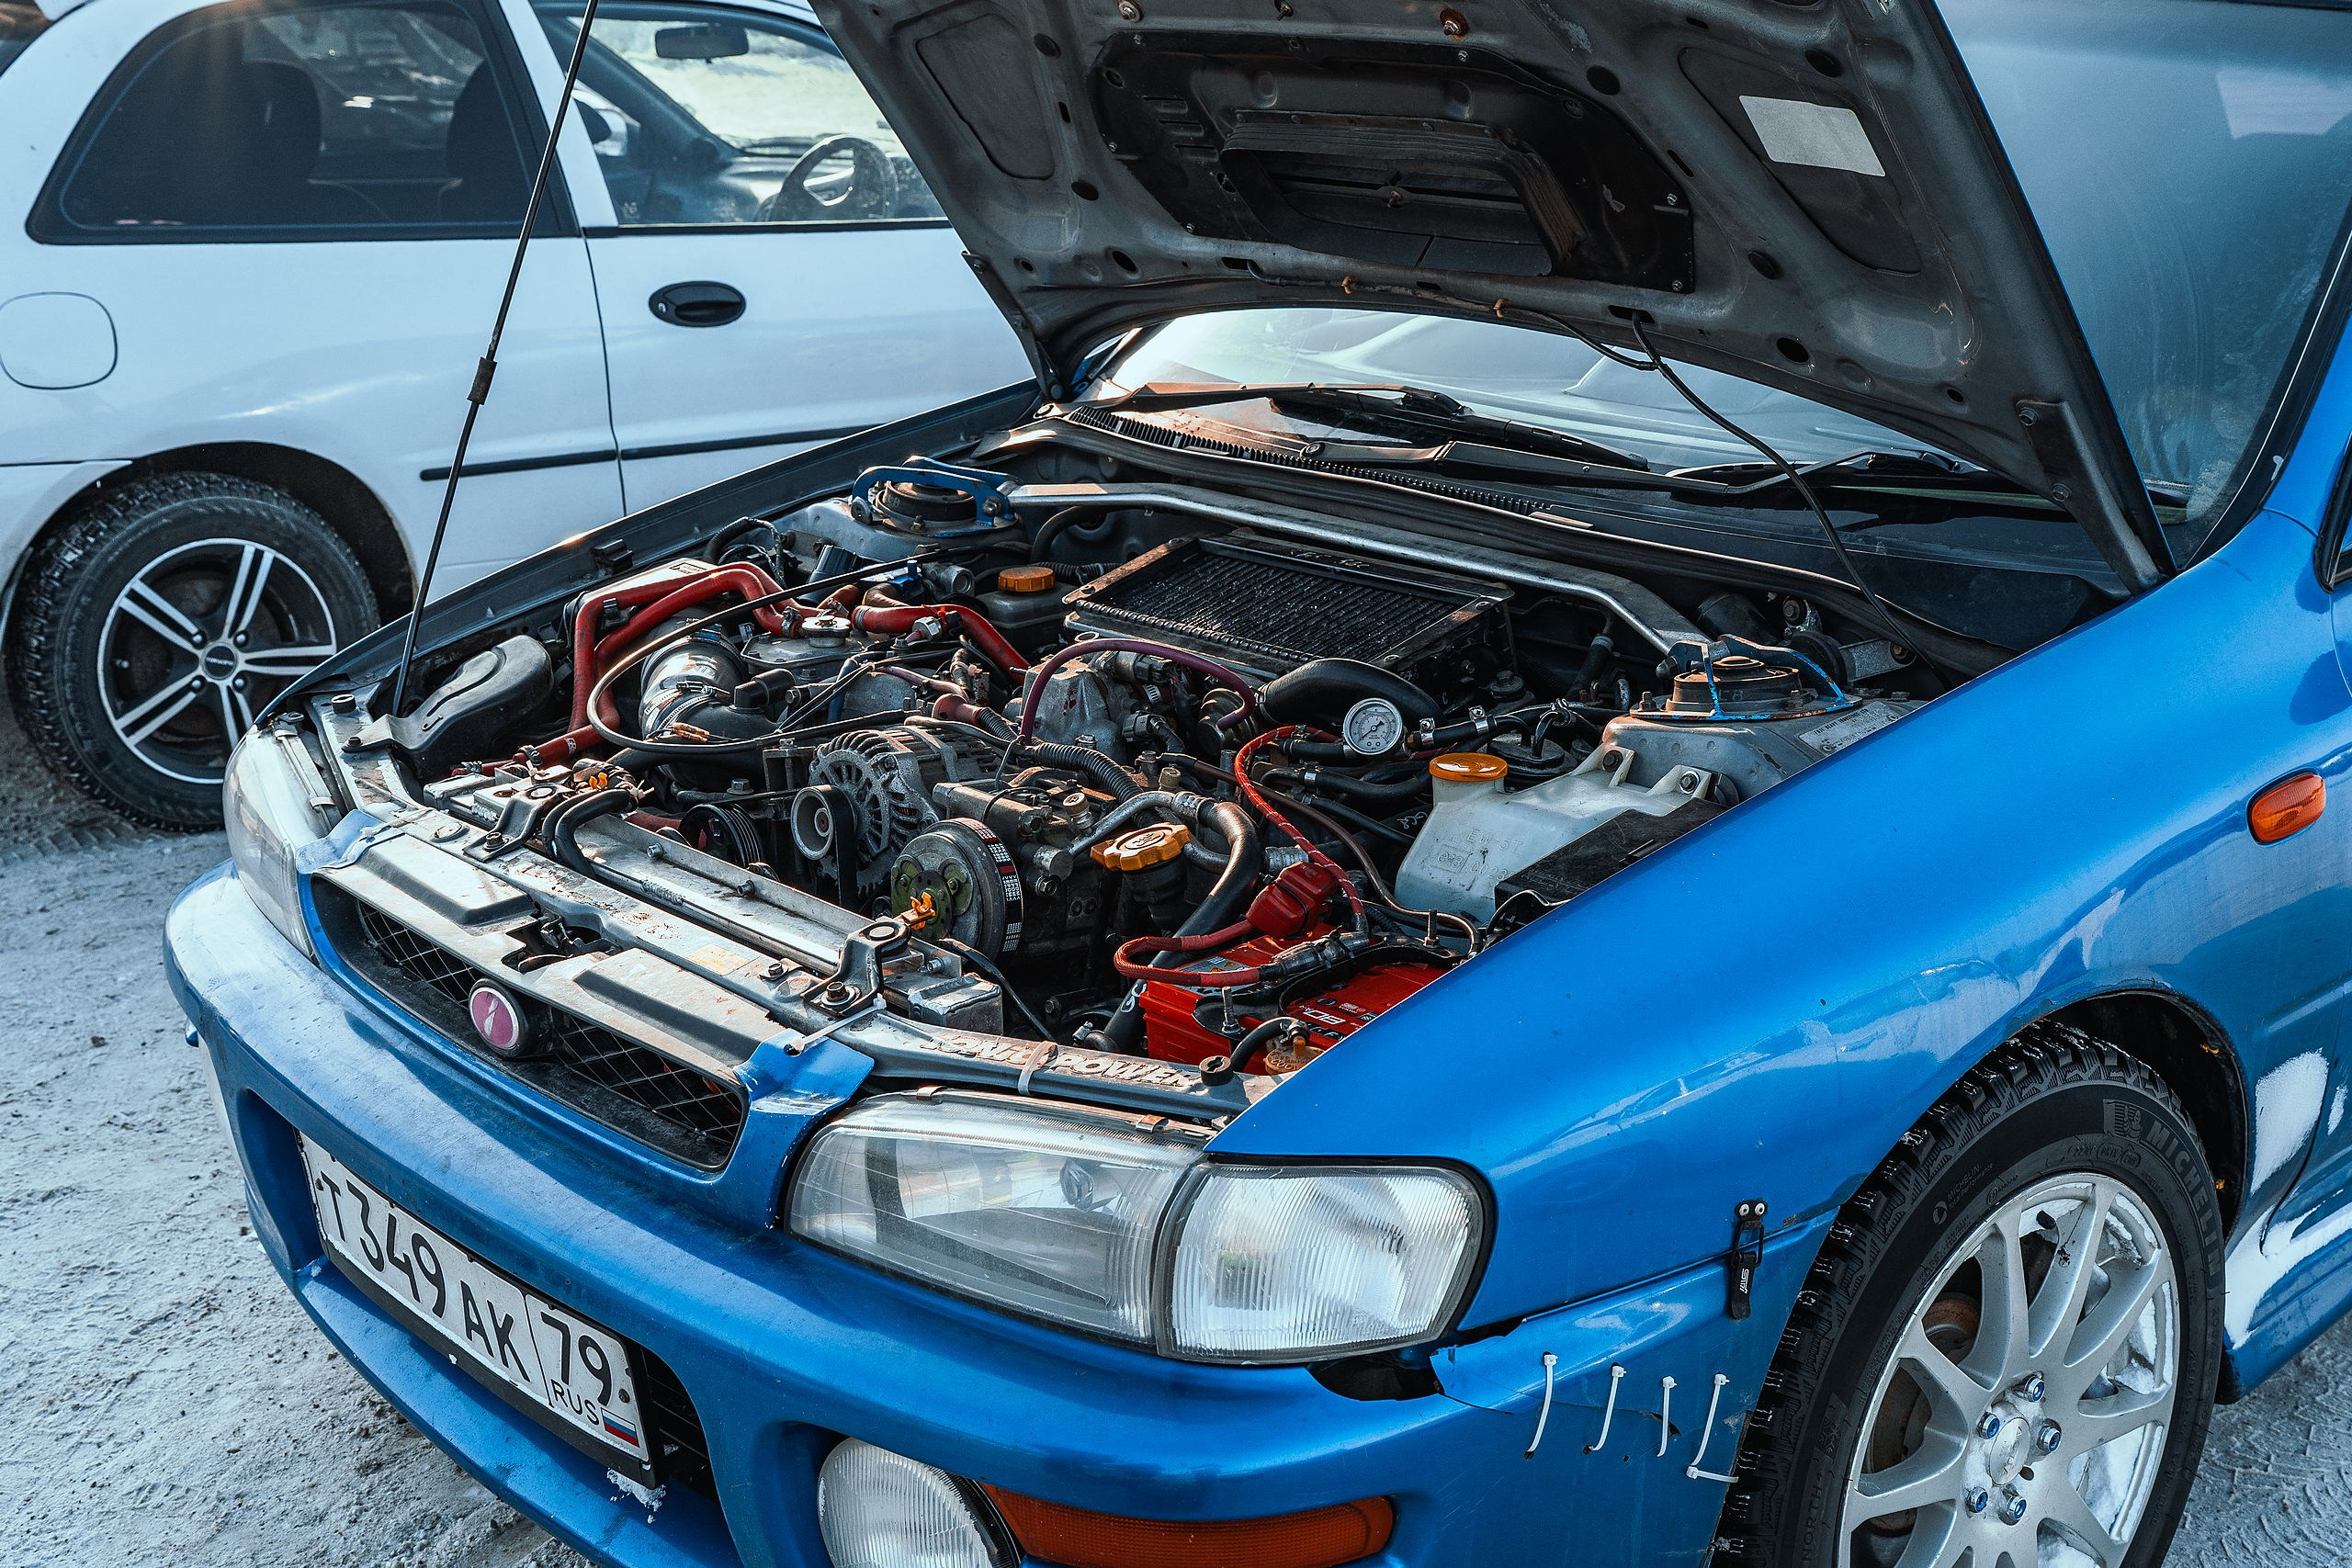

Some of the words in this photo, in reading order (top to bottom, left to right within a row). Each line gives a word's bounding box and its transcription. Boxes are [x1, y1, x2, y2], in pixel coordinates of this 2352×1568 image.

[2146, 1120, 2222, 1277] MICHELIN
[540, 1312, 614, 1405] 79
[551, 1380, 600, 1427] RUS
